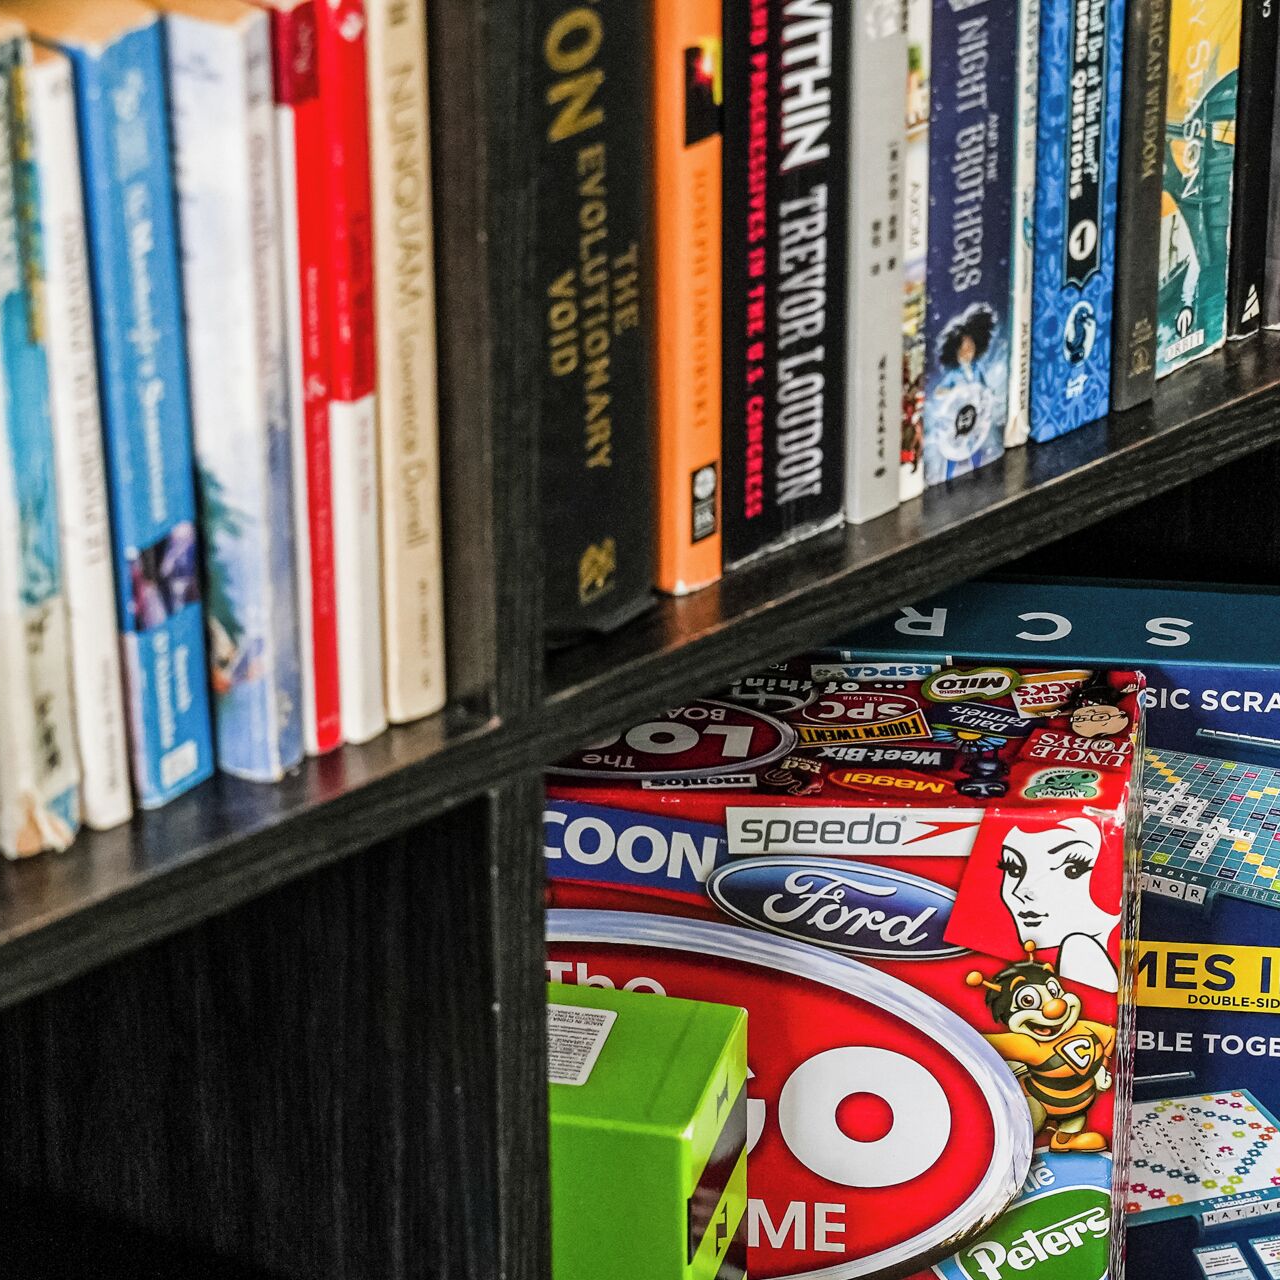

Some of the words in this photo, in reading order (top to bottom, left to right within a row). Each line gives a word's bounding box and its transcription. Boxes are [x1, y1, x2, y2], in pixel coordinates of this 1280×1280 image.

[543, 0, 605, 143] ON
[955, 15, 988, 112] NIGHT
[1087, 36, 1103, 63] Be
[1086, 65, 1103, 86] at
[1084, 88, 1102, 123] This
[1181, 40, 1212, 200] SEASON
[1068, 71, 1090, 201] QUESTIONS
[1140, 89, 1160, 182] WISDOM
[386, 60, 428, 307] NUNQUAM
[953, 122, 988, 293] BROTHERS
[777, 186, 829, 340] TREVOR
[576, 143, 613, 470] EVOLUTIONARY
[616, 243, 639, 335] THE
[746, 284, 766, 338] THE
[546, 270, 577, 377] VOID
[776, 343, 826, 505] LOUDON
[744, 396, 765, 520] CONGRESS
[820, 680, 860, 694] of
[842, 664, 933, 679] RSPCA
[935, 676, 1006, 691] MILO
[819, 701, 908, 718] SPC
[949, 704, 1031, 729] Farmers
[949, 715, 1010, 736] Dairy
[583, 753, 636, 769] The
[817, 746, 943, 766] Weet-Bix
[1029, 743, 1126, 766] UNCLE
[649, 775, 752, 788] mentos
[844, 772, 946, 794] Maggi
[741, 812, 902, 852] speedo
[763, 870, 938, 948] Ford
